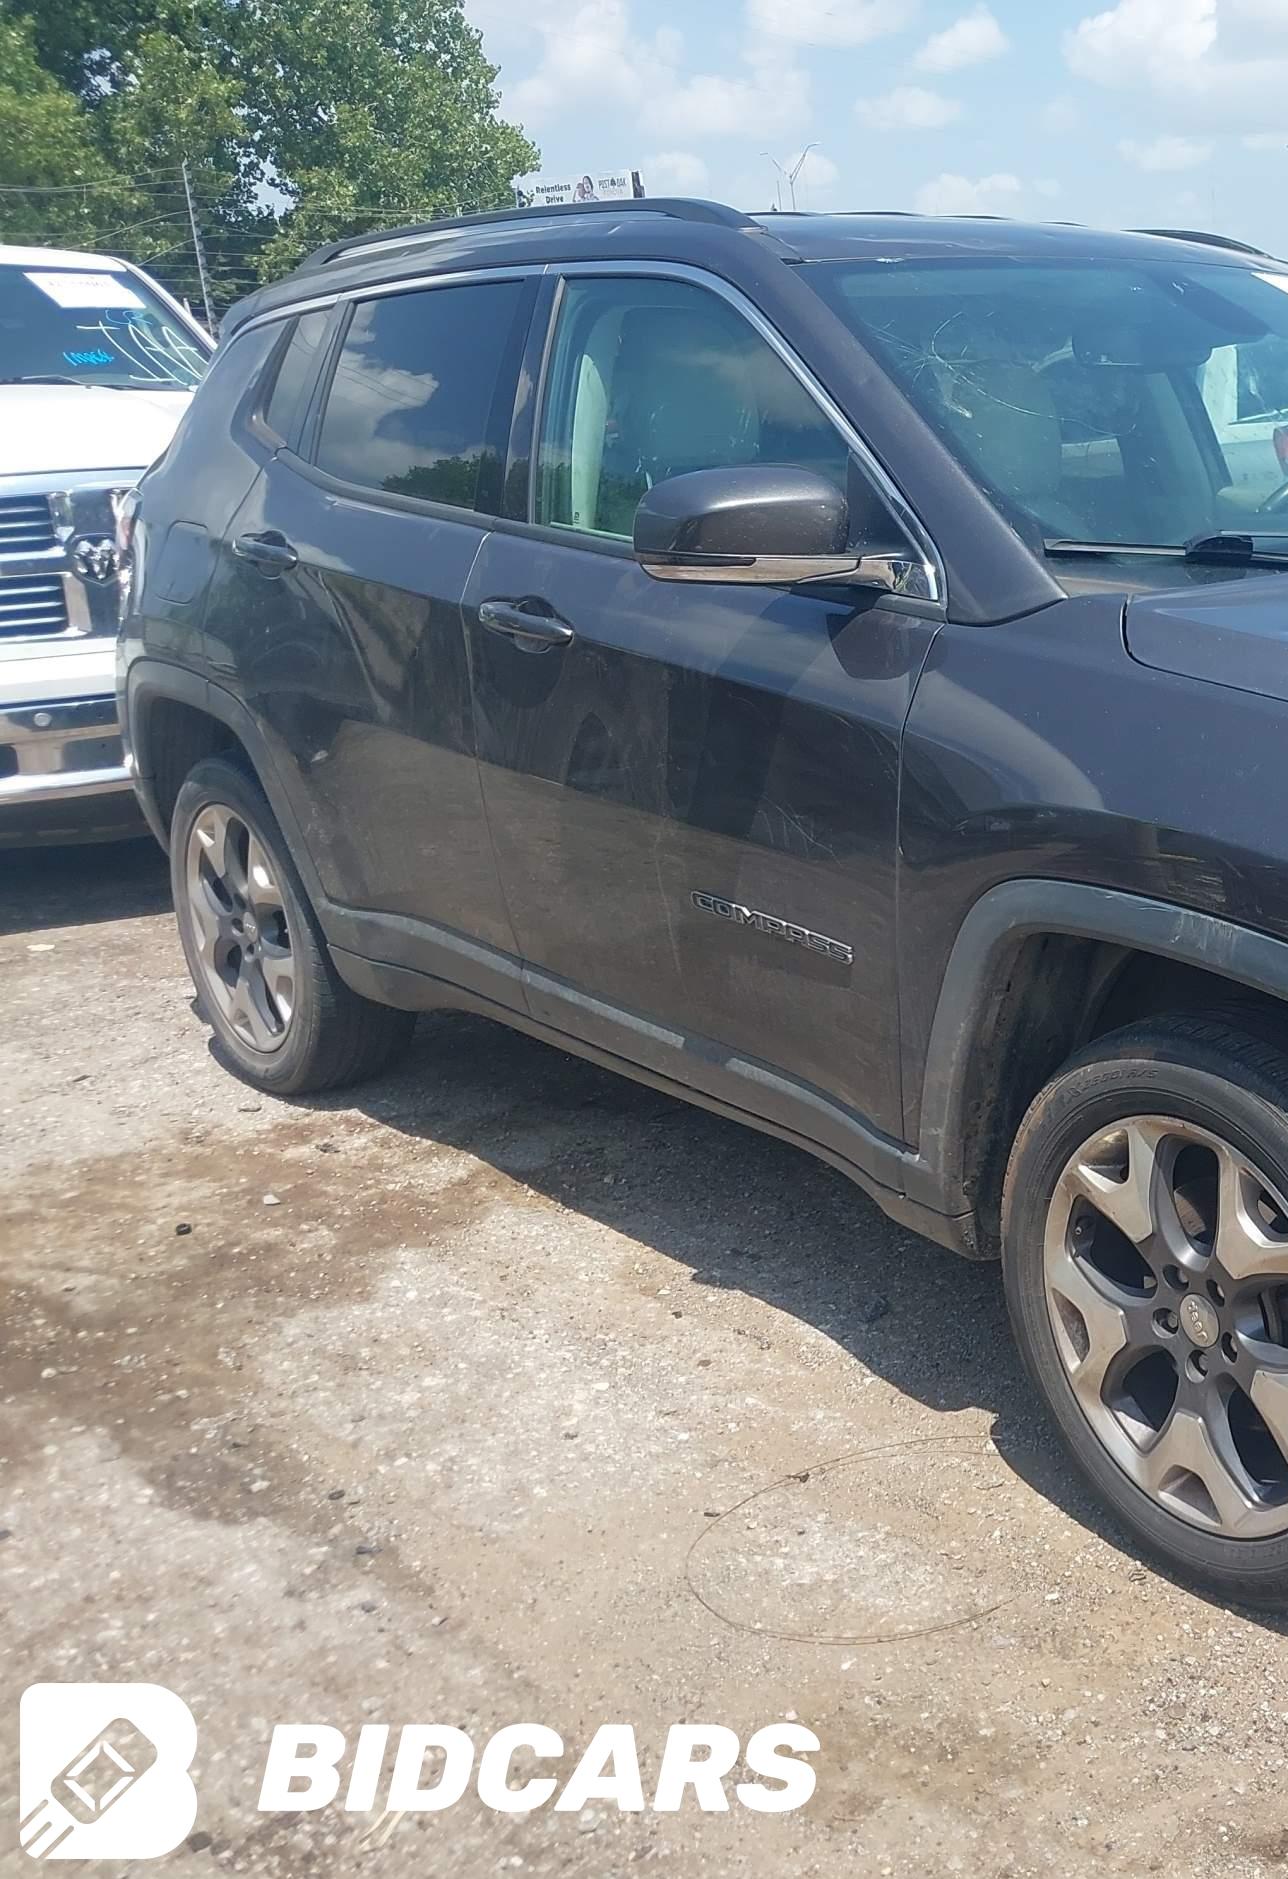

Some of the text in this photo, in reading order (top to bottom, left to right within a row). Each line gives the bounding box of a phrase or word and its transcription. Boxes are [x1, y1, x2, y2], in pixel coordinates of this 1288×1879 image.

[535, 183, 571, 194] Relentless
[545, 195, 564, 204] Drive
[691, 890, 853, 965] COMPASS
[1187, 1300, 1209, 1344] Jeep
